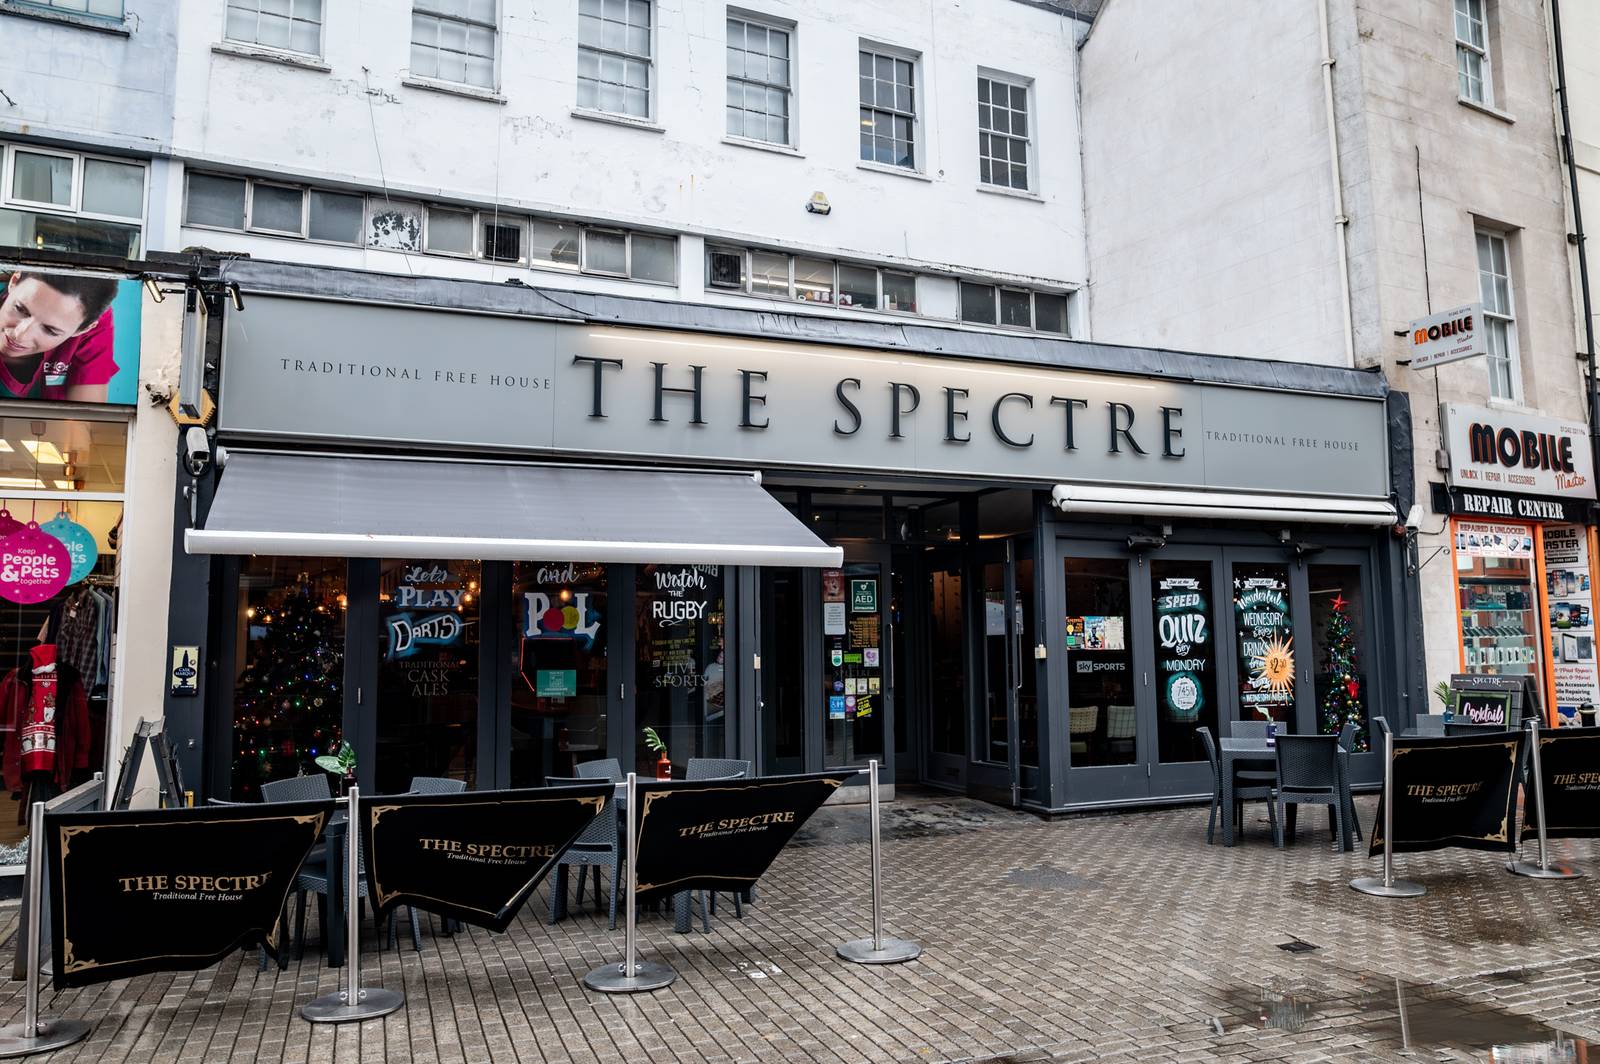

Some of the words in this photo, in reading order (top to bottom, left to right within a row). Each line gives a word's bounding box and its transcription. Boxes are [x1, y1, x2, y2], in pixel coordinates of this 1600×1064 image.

[1414, 315, 1473, 345] MOBILE
[280, 358, 422, 381] TRADITIONAL
[434, 370, 478, 386] FREE
[490, 374, 552, 391] HOUSE
[573, 354, 770, 432] THE
[833, 377, 1187, 461] SPECTRE
[1206, 430, 1285, 446] TRADITIONAL
[1292, 437, 1318, 448] FREE
[1324, 440, 1359, 451] HOUSE
[1469, 422, 1575, 474] MOBILE
[1460, 469, 1478, 480] UNLOCK
[1485, 472, 1501, 481] REPAIR
[1508, 474, 1536, 486] ACCESSORIES
[1554, 472, 1586, 491] Master
[1463, 493, 1513, 515] REPAIR
[1518, 499, 1564, 520] CENTER
[1459, 523, 1489, 533] REPAIRED
[1495, 526, 1526, 535] UNLOCKED
[2, 553, 57, 567] People
[0, 565, 20, 582] &
[20, 565, 60, 578] Pets
[537, 566, 579, 584] and
[654, 569, 707, 590] Watch
[400, 586, 462, 608] PLAY
[1166, 594, 1200, 608] SPEED
[1237, 588, 1282, 610] Wonderful
[653, 601, 707, 620] RUGBY
[1243, 612, 1285, 626] WEDNESDAY
[393, 615, 460, 651] DARTS
[1159, 614, 1206, 648] QUIZ
[667, 663, 696, 675] LIVE
[1079, 661, 1091, 672] sky
[1093, 663, 1126, 671] SPORTS
[1166, 659, 1206, 671] MONDAY
[407, 670, 450, 683] CASK
[655, 675, 708, 688] SPORTS
[1472, 677, 1502, 686] SPECTRE
[411, 683, 448, 697] ALES
[1463, 702, 1504, 725] Cocktails
[1553, 774, 1576, 785] THE
[1407, 784, 1434, 796] THE
[679, 822, 714, 837] THE
[718, 811, 795, 830] SPECTRE
[420, 838, 462, 852] THE
[466, 843, 556, 857] SPECTRE
[446, 852, 486, 863] Traditional
[119, 875, 168, 892] THE
[153, 892, 197, 900] Traditional
[199, 892, 216, 900] Free
[218, 893, 243, 901] House
